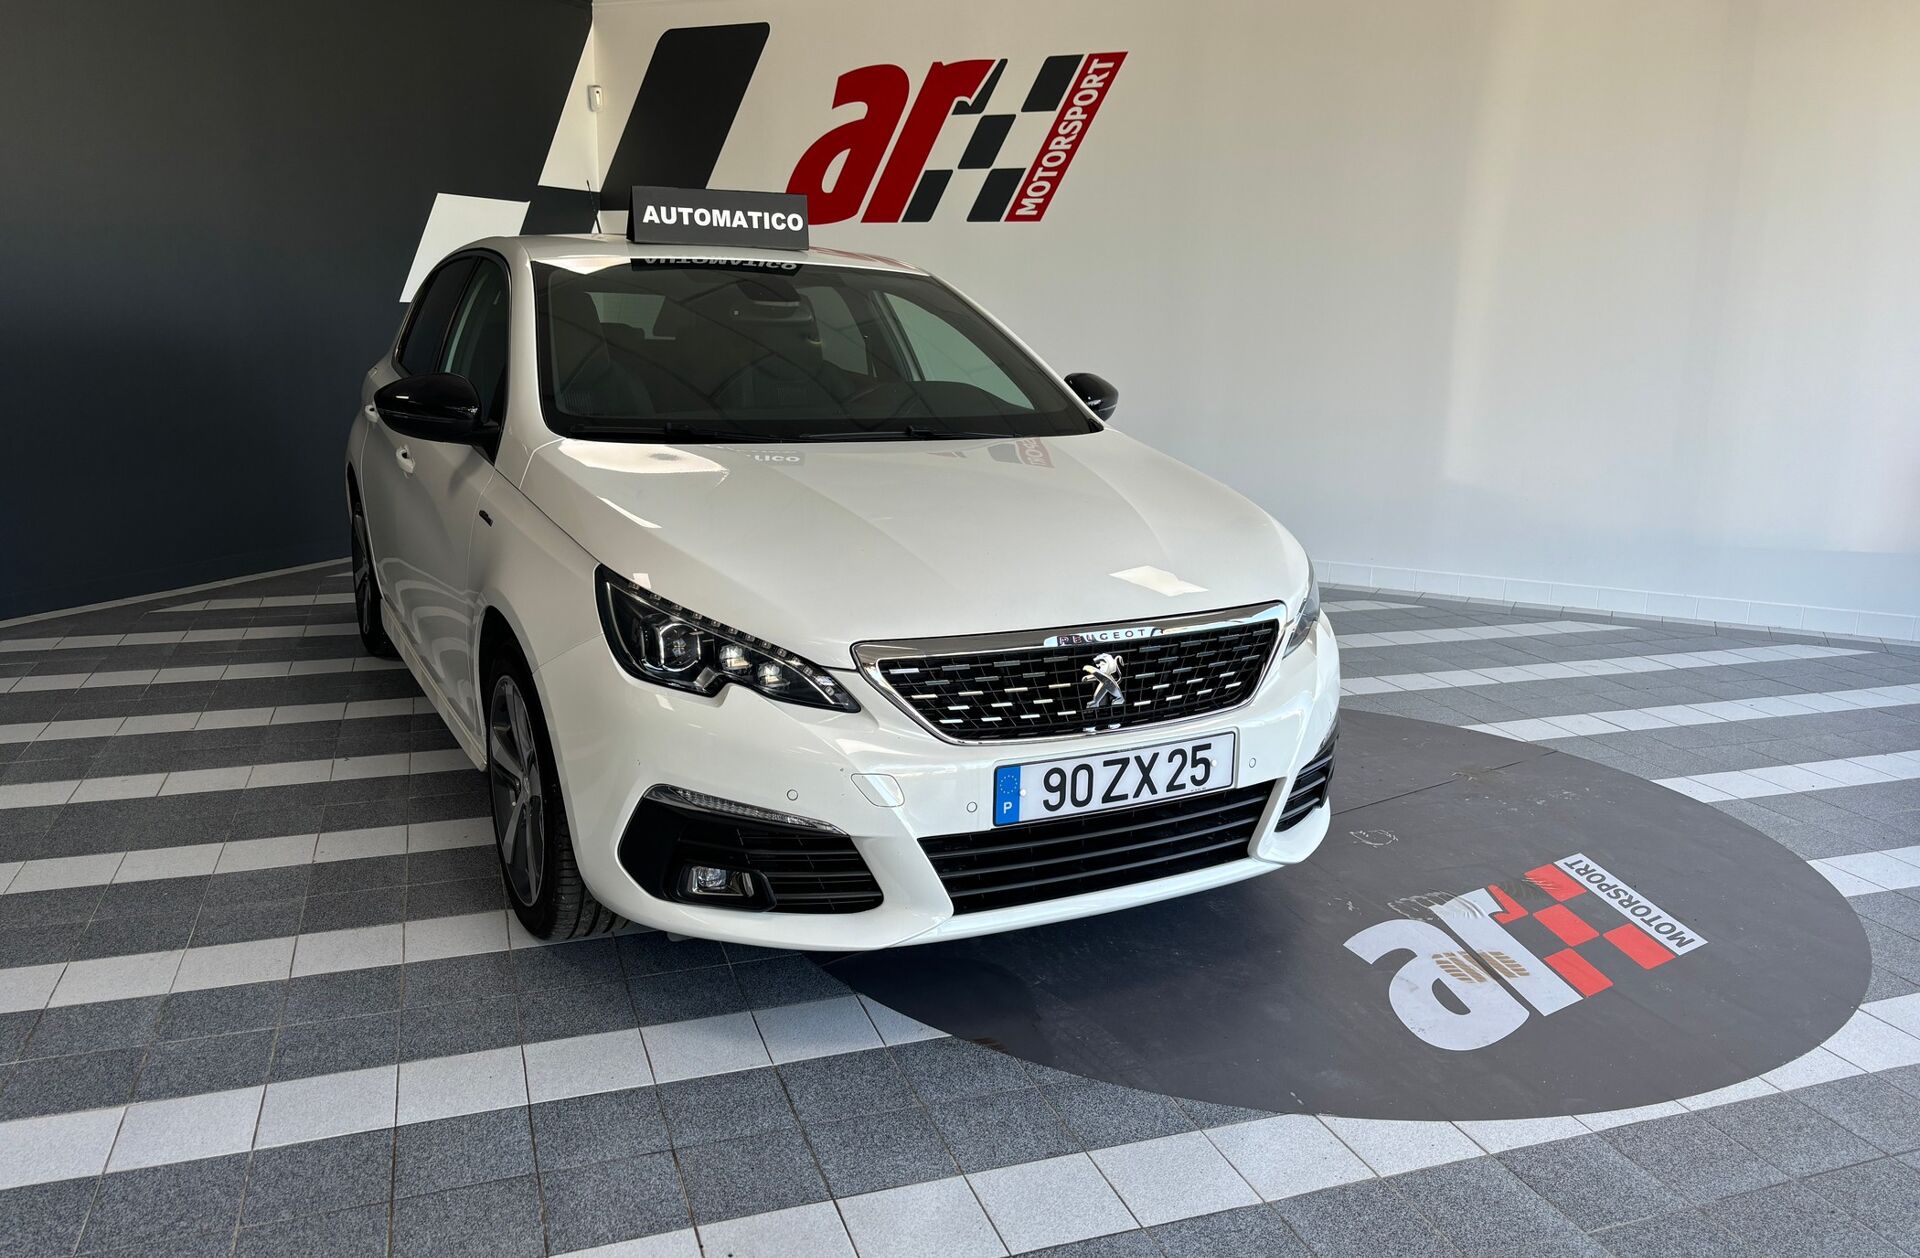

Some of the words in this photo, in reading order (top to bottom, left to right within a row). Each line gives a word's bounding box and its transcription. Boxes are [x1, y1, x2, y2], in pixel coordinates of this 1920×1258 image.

[784, 59, 997, 225] ar
[1015, 58, 1115, 216] MOTORSPORT
[642, 205, 804, 231] AUTOMATICO
[1058, 628, 1146, 646] PEUGEOT
[1003, 801, 1013, 814] P
[1563, 859, 1696, 949] MOTORSPORT
